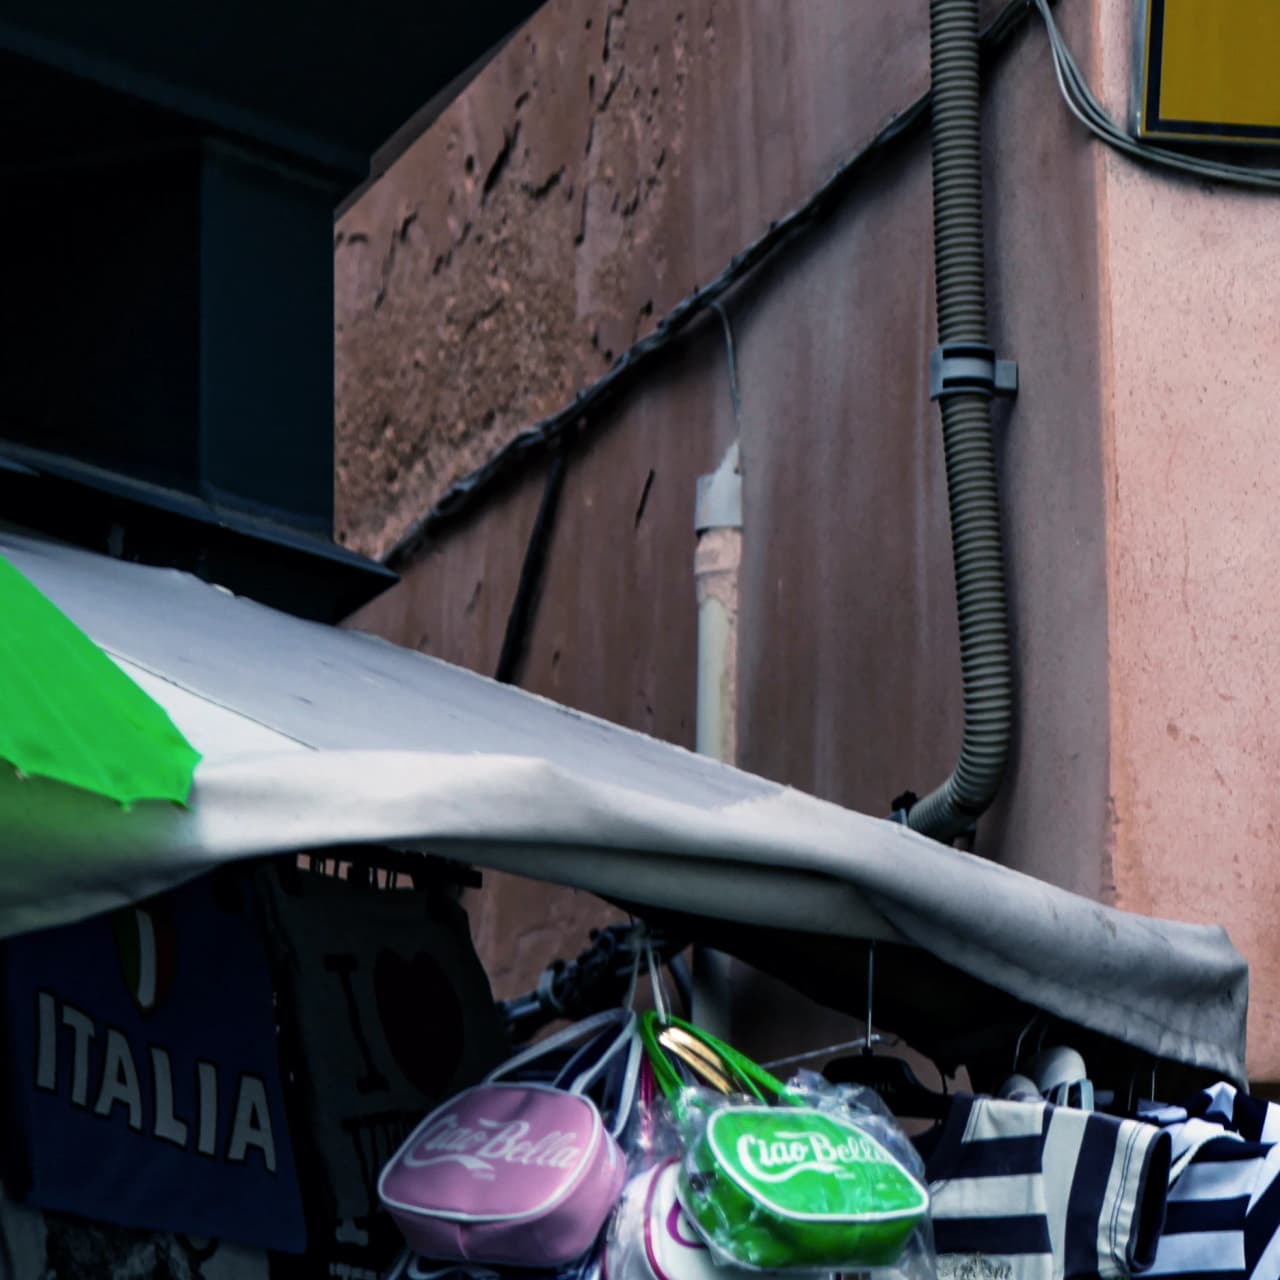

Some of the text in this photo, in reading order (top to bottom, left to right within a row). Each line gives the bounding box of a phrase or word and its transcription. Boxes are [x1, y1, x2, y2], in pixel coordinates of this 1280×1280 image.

[34, 991, 278, 1174] ITALIA
[403, 1114, 492, 1169] Ciao
[477, 1119, 581, 1169] Bella
[737, 1132, 897, 1182] Ciao Bella
